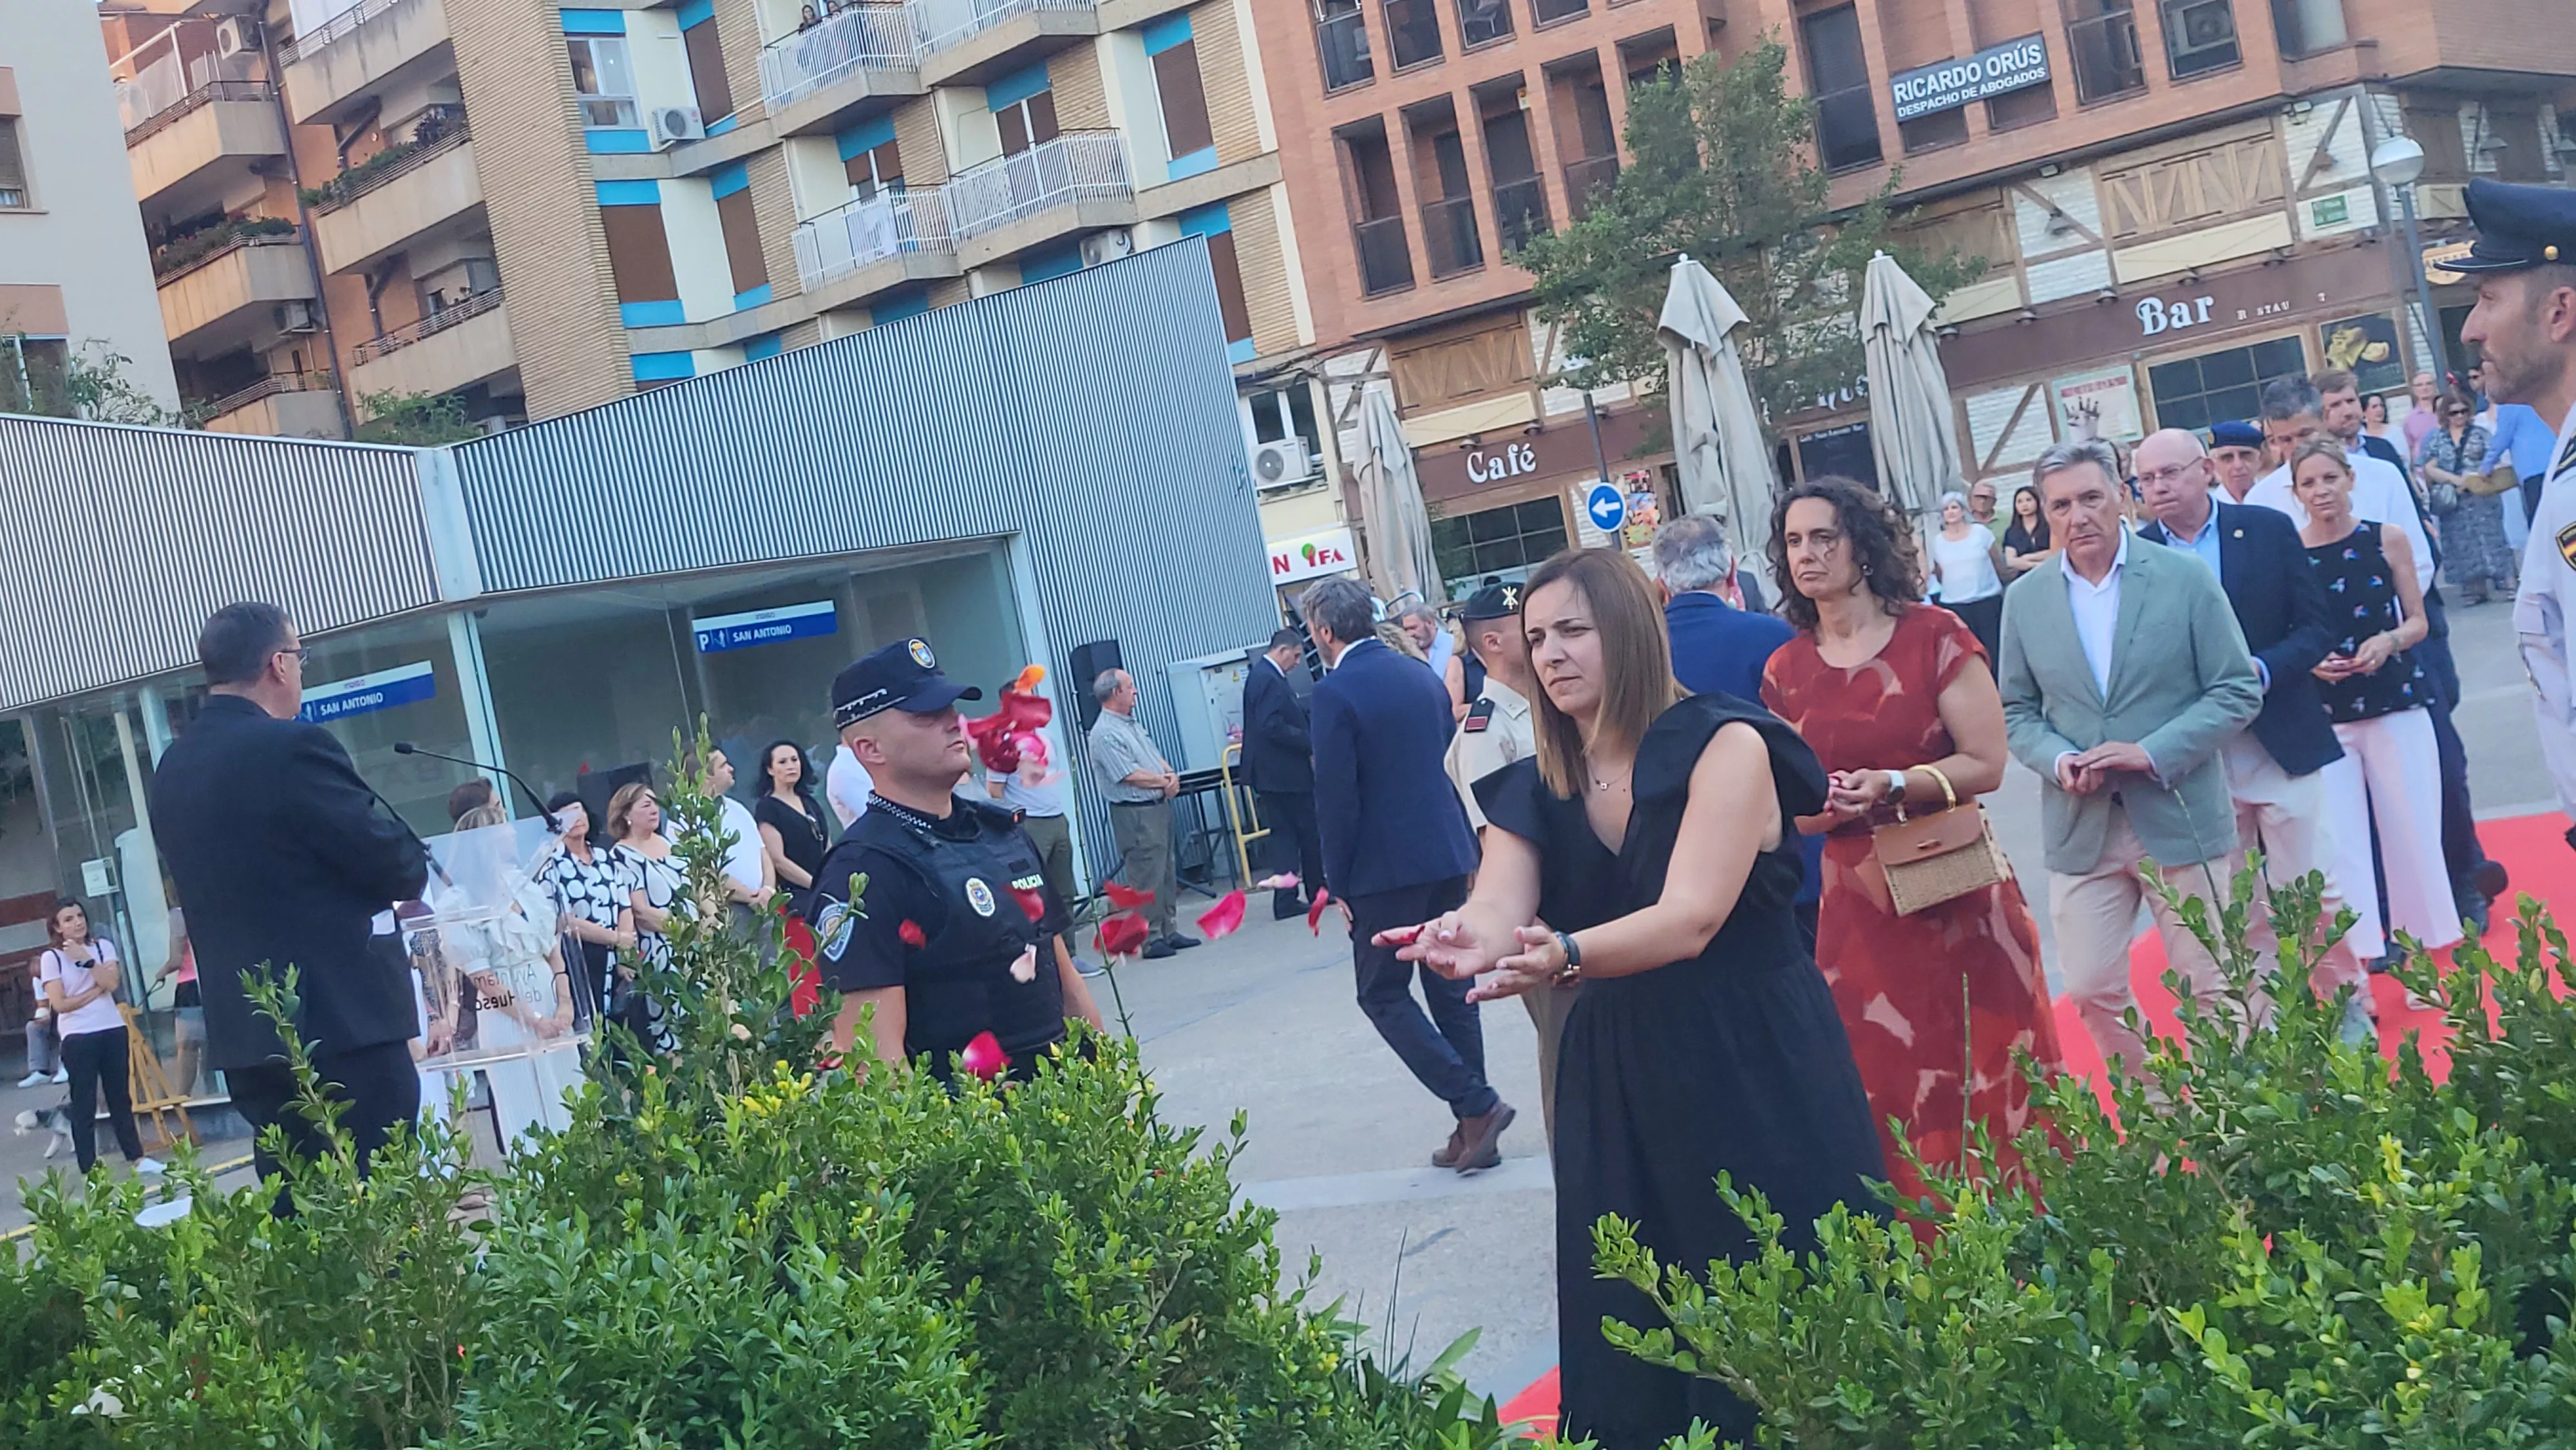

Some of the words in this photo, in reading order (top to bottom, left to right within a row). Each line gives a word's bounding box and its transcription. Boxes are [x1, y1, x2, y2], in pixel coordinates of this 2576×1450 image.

[1893, 62, 1982, 104] RICARDO
[1985, 44, 2043, 77] ORÚS
[1897, 91, 1960, 118] DESPACHO
[1961, 87, 1978, 100] DE
[1979, 67, 2046, 95] ABOGADOS
[2136, 296, 2214, 335] Bar
[1467, 443, 1537, 484] Café
[698, 634, 709, 652] P
[733, 630, 752, 643] SAN
[753, 624, 792, 640] ANTONIO
[321, 702, 340, 716] SAN
[341, 692, 384, 711] ANTONIO
